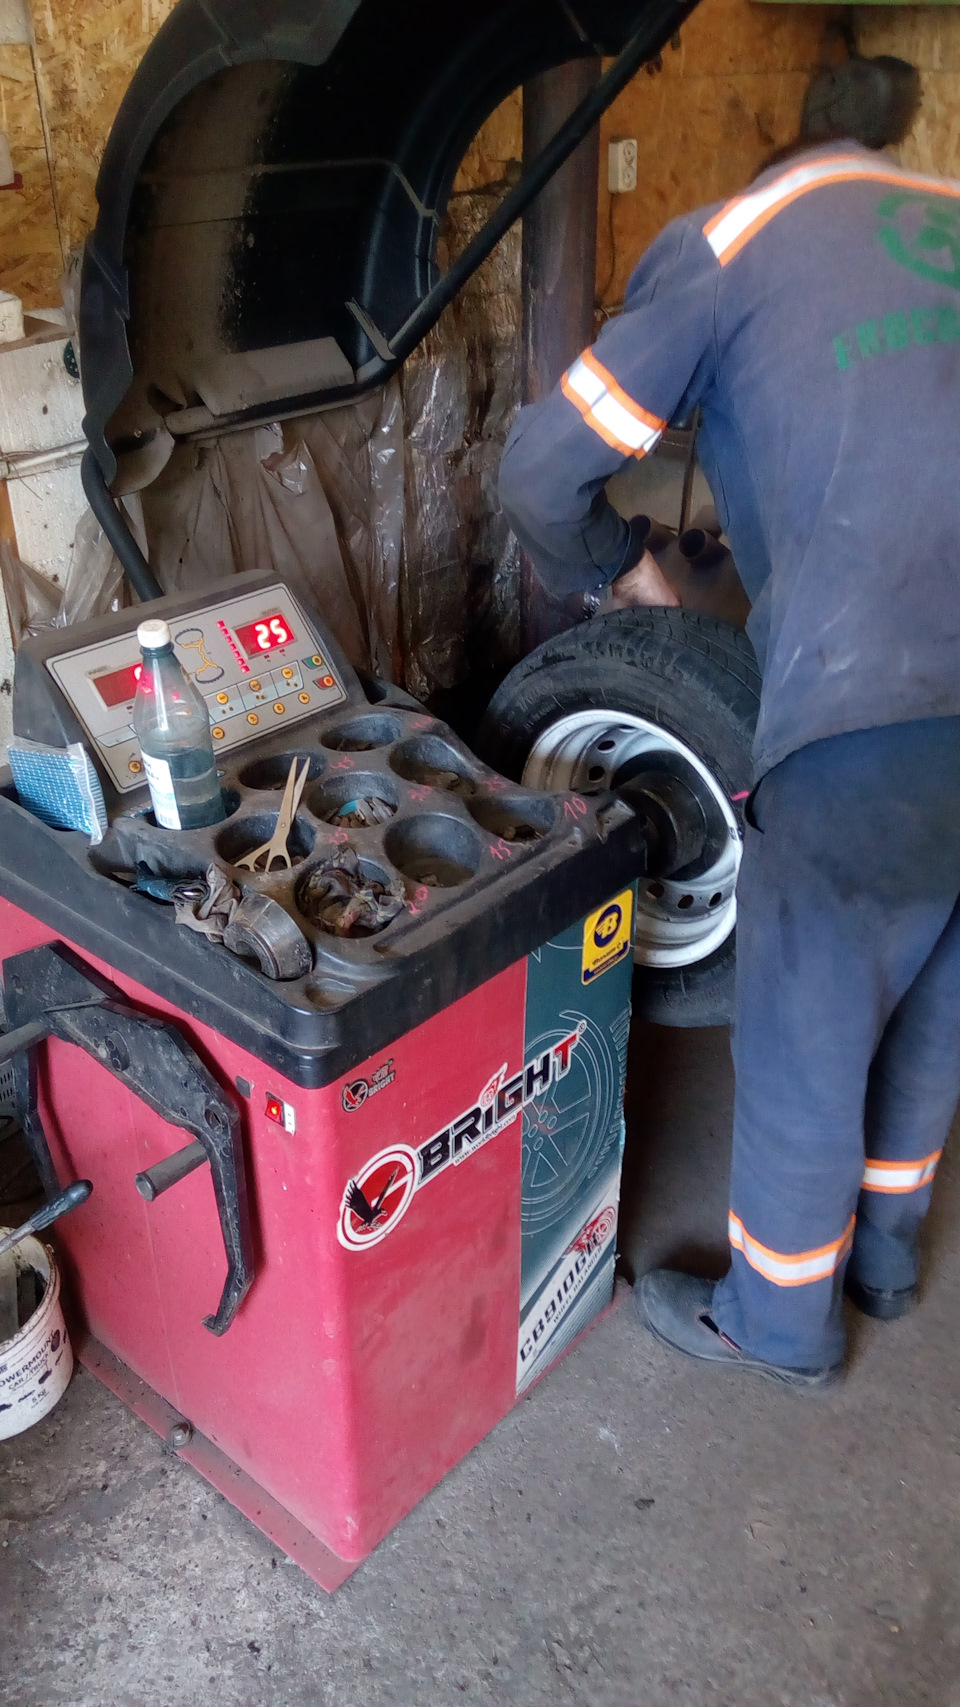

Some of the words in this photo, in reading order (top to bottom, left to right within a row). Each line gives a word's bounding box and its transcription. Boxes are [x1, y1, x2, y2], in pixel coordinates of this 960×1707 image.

[255, 619, 287, 649] 25
[564, 796, 587, 820] 10
[553, 1294, 572, 1324] WHEEL
[9, 1377, 24, 1390] CAR
